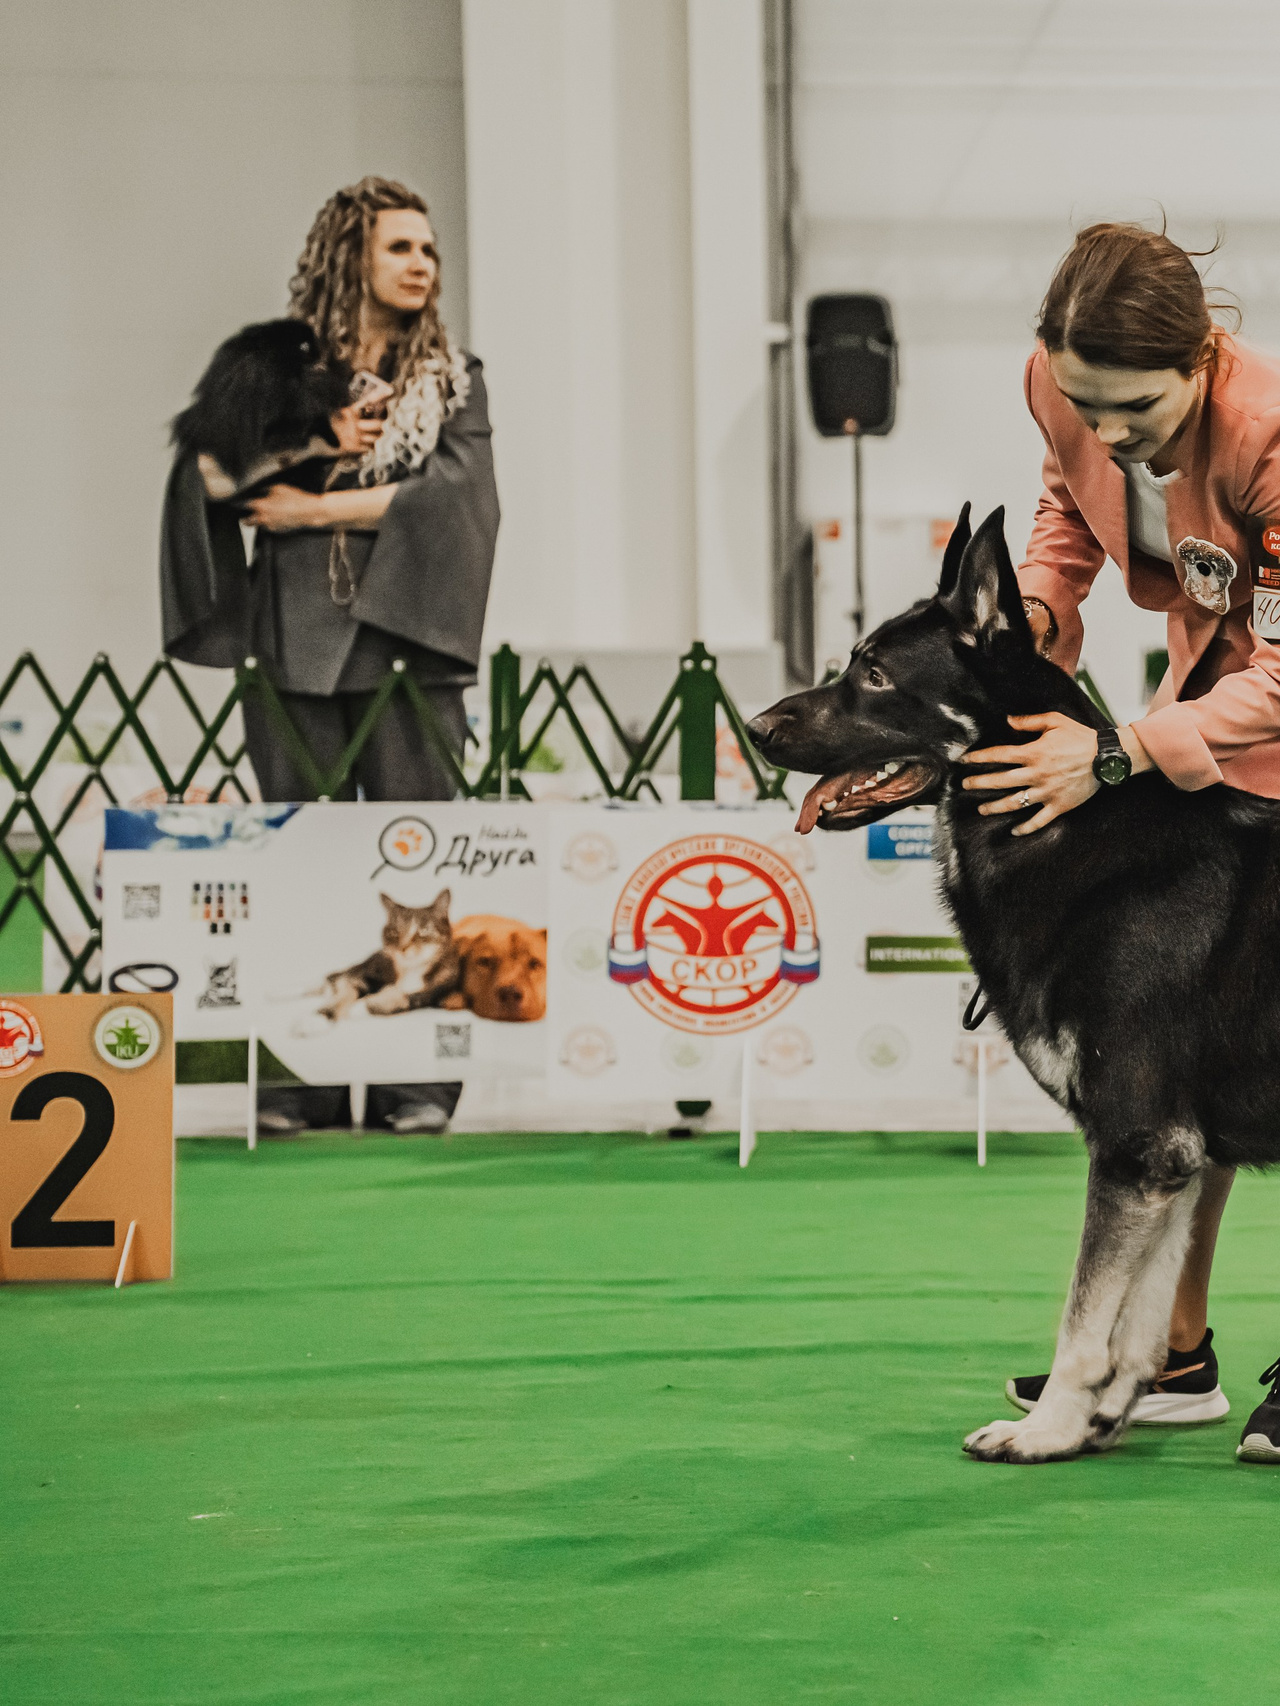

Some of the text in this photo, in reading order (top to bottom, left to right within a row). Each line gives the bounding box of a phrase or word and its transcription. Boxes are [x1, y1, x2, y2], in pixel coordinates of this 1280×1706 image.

[434, 834, 537, 877] Друга
[671, 959, 757, 982] СКОР
[11, 1071, 115, 1248] 2
